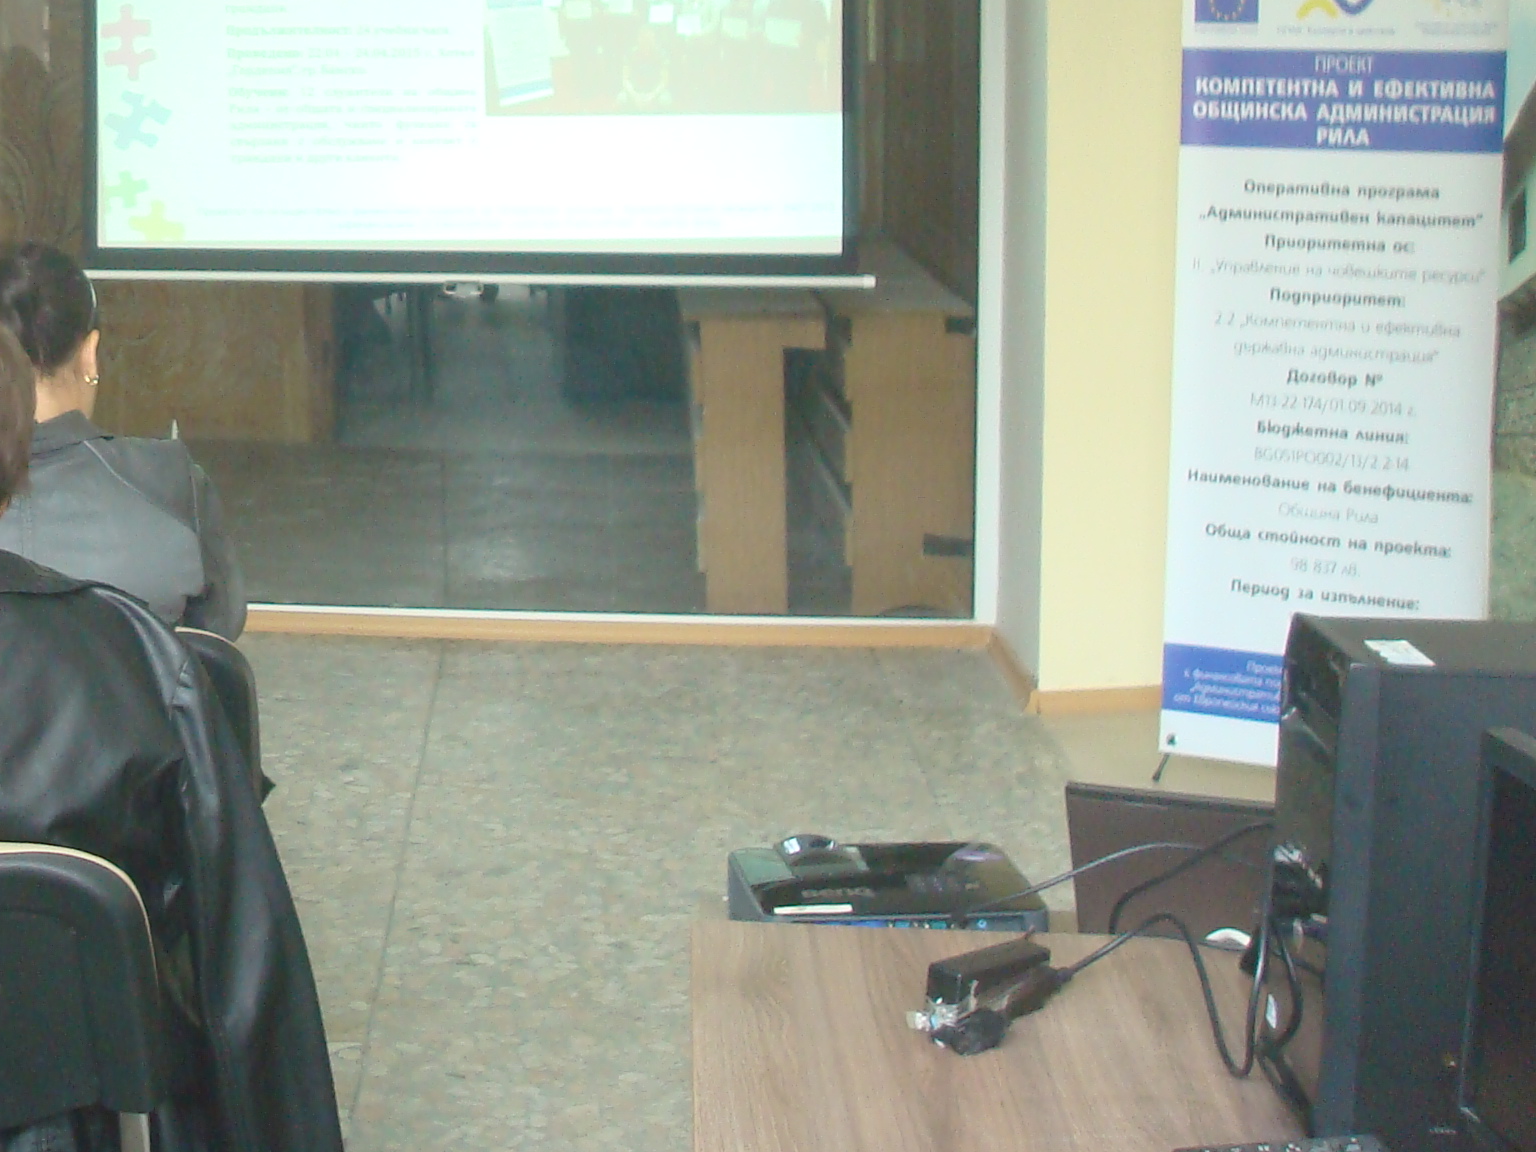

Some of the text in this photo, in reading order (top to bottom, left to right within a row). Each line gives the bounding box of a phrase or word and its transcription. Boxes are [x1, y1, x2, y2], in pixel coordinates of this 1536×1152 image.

[1315, 54, 1374, 74] ПРОЕКТ
[1195, 76, 1496, 100] КОМПЕТЕНТНА И ЕФЕКТИВНА
[1192, 100, 1496, 127] ОБЩИНСКА АДМИНИСТРАЦИЯ
[1316, 127, 1371, 147] РИЛА
[1243, 178, 1441, 201] Оперативна програма
[1199, 204, 1370, 225] „Административен
[1263, 233, 1386, 255] Приоритетна
[1269, 286, 1407, 310] Подприоритет:
[1286, 368, 1358, 390] Договор
[1257, 419, 1410, 445] Бюджетна линия:
[1187, 468, 1474, 504] Наименование на бенефициента:
[1205, 522, 1452, 559] Обща стойност на проекта:
[1230, 578, 1420, 611] Период за изпълнение:
